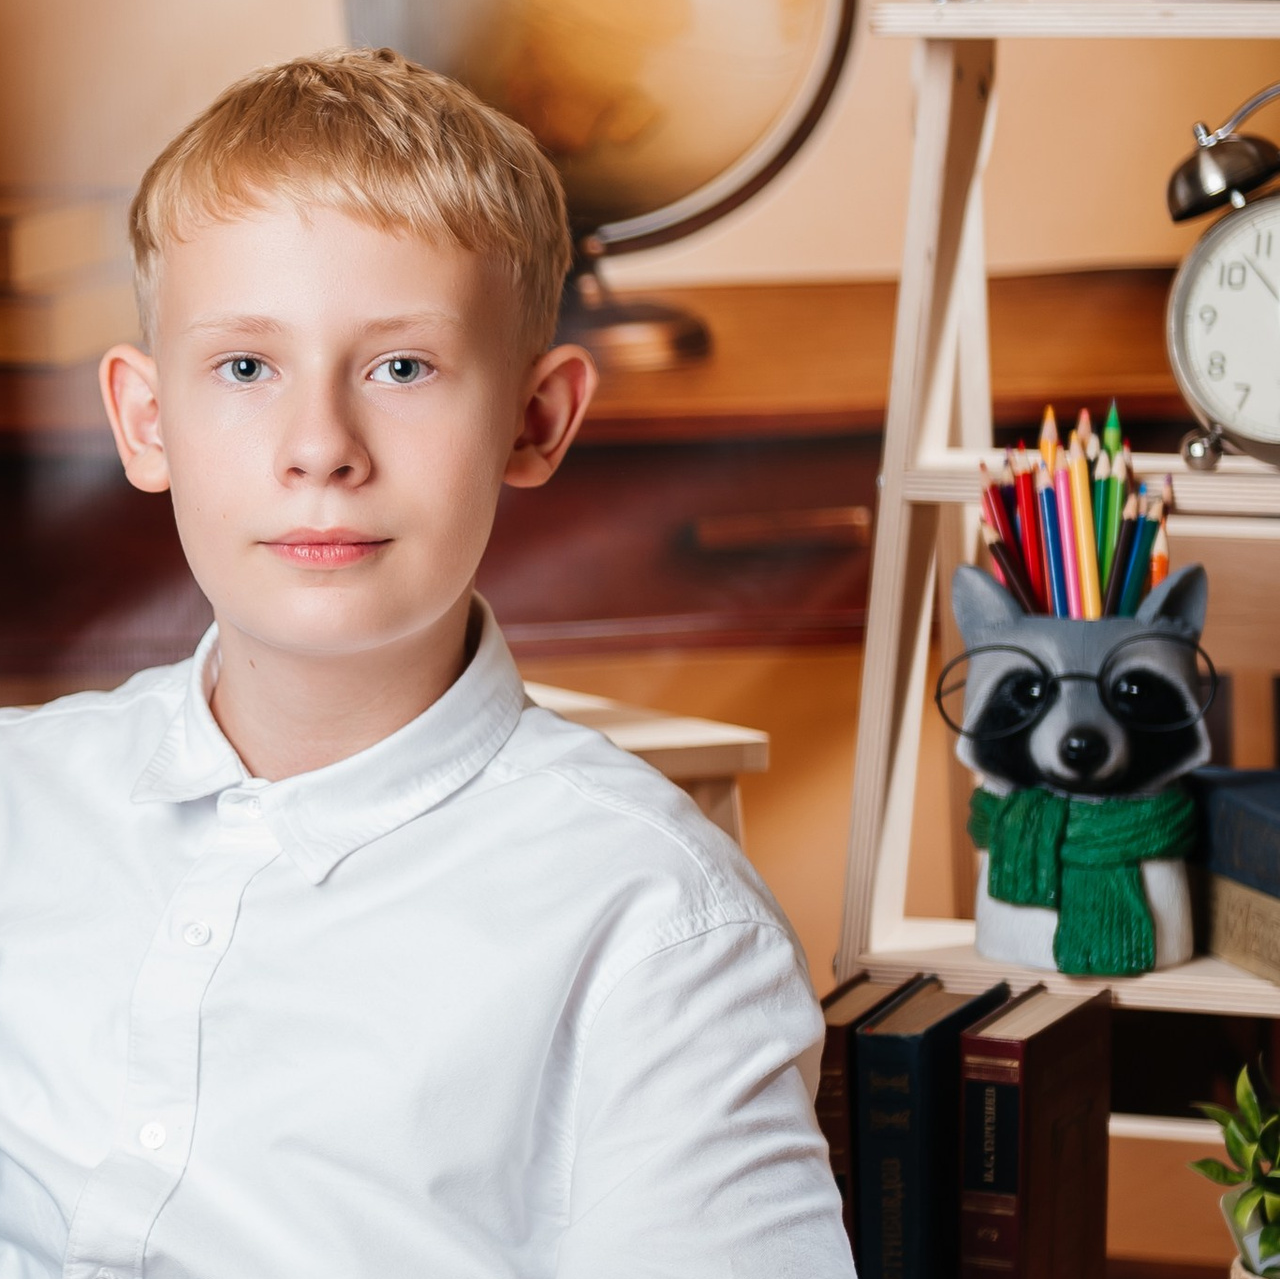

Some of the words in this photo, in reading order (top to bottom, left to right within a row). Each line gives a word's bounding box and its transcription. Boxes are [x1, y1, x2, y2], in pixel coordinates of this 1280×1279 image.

[1219, 261, 1246, 290] 10
[1207, 350, 1227, 382] 8
[1233, 382, 1251, 412] 7
